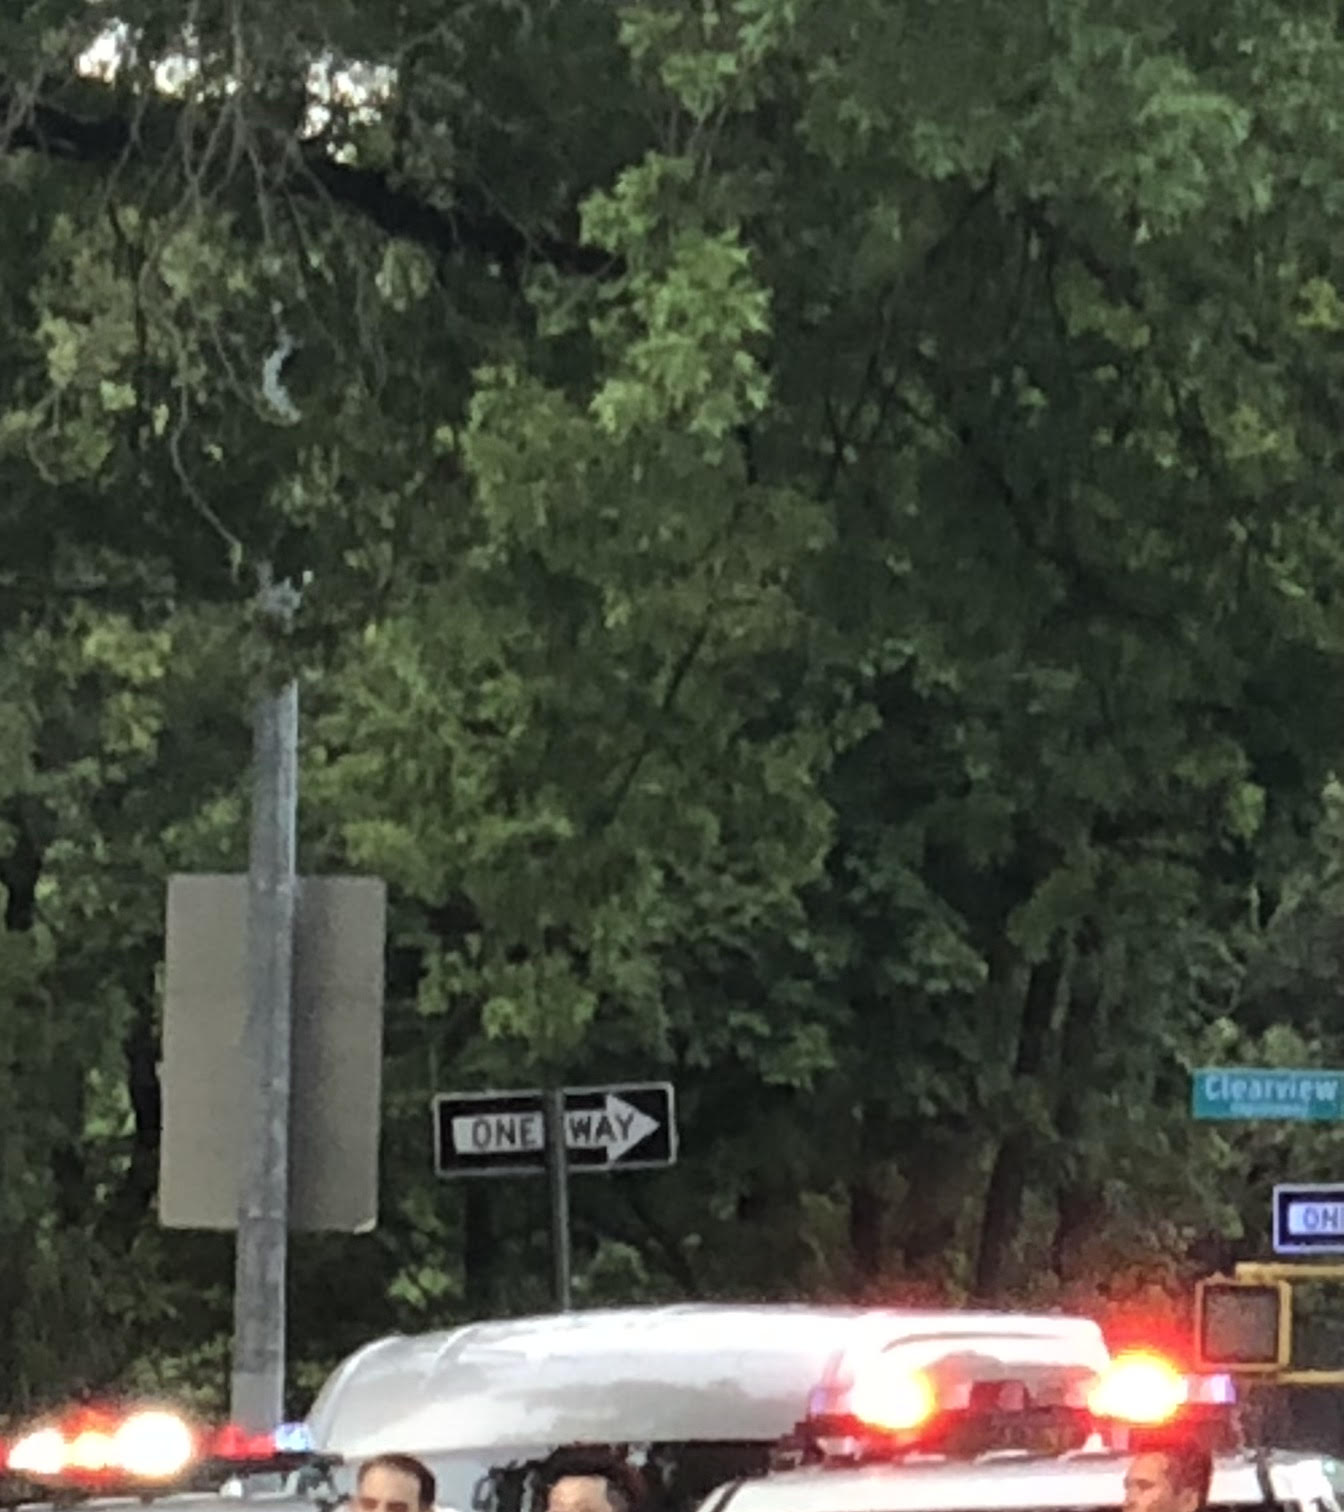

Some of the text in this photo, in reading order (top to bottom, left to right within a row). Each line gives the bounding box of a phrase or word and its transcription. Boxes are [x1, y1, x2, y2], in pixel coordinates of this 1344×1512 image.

[1204, 1074, 1339, 1101] Clearview
[471, 1113, 634, 1148] ONE WAY
